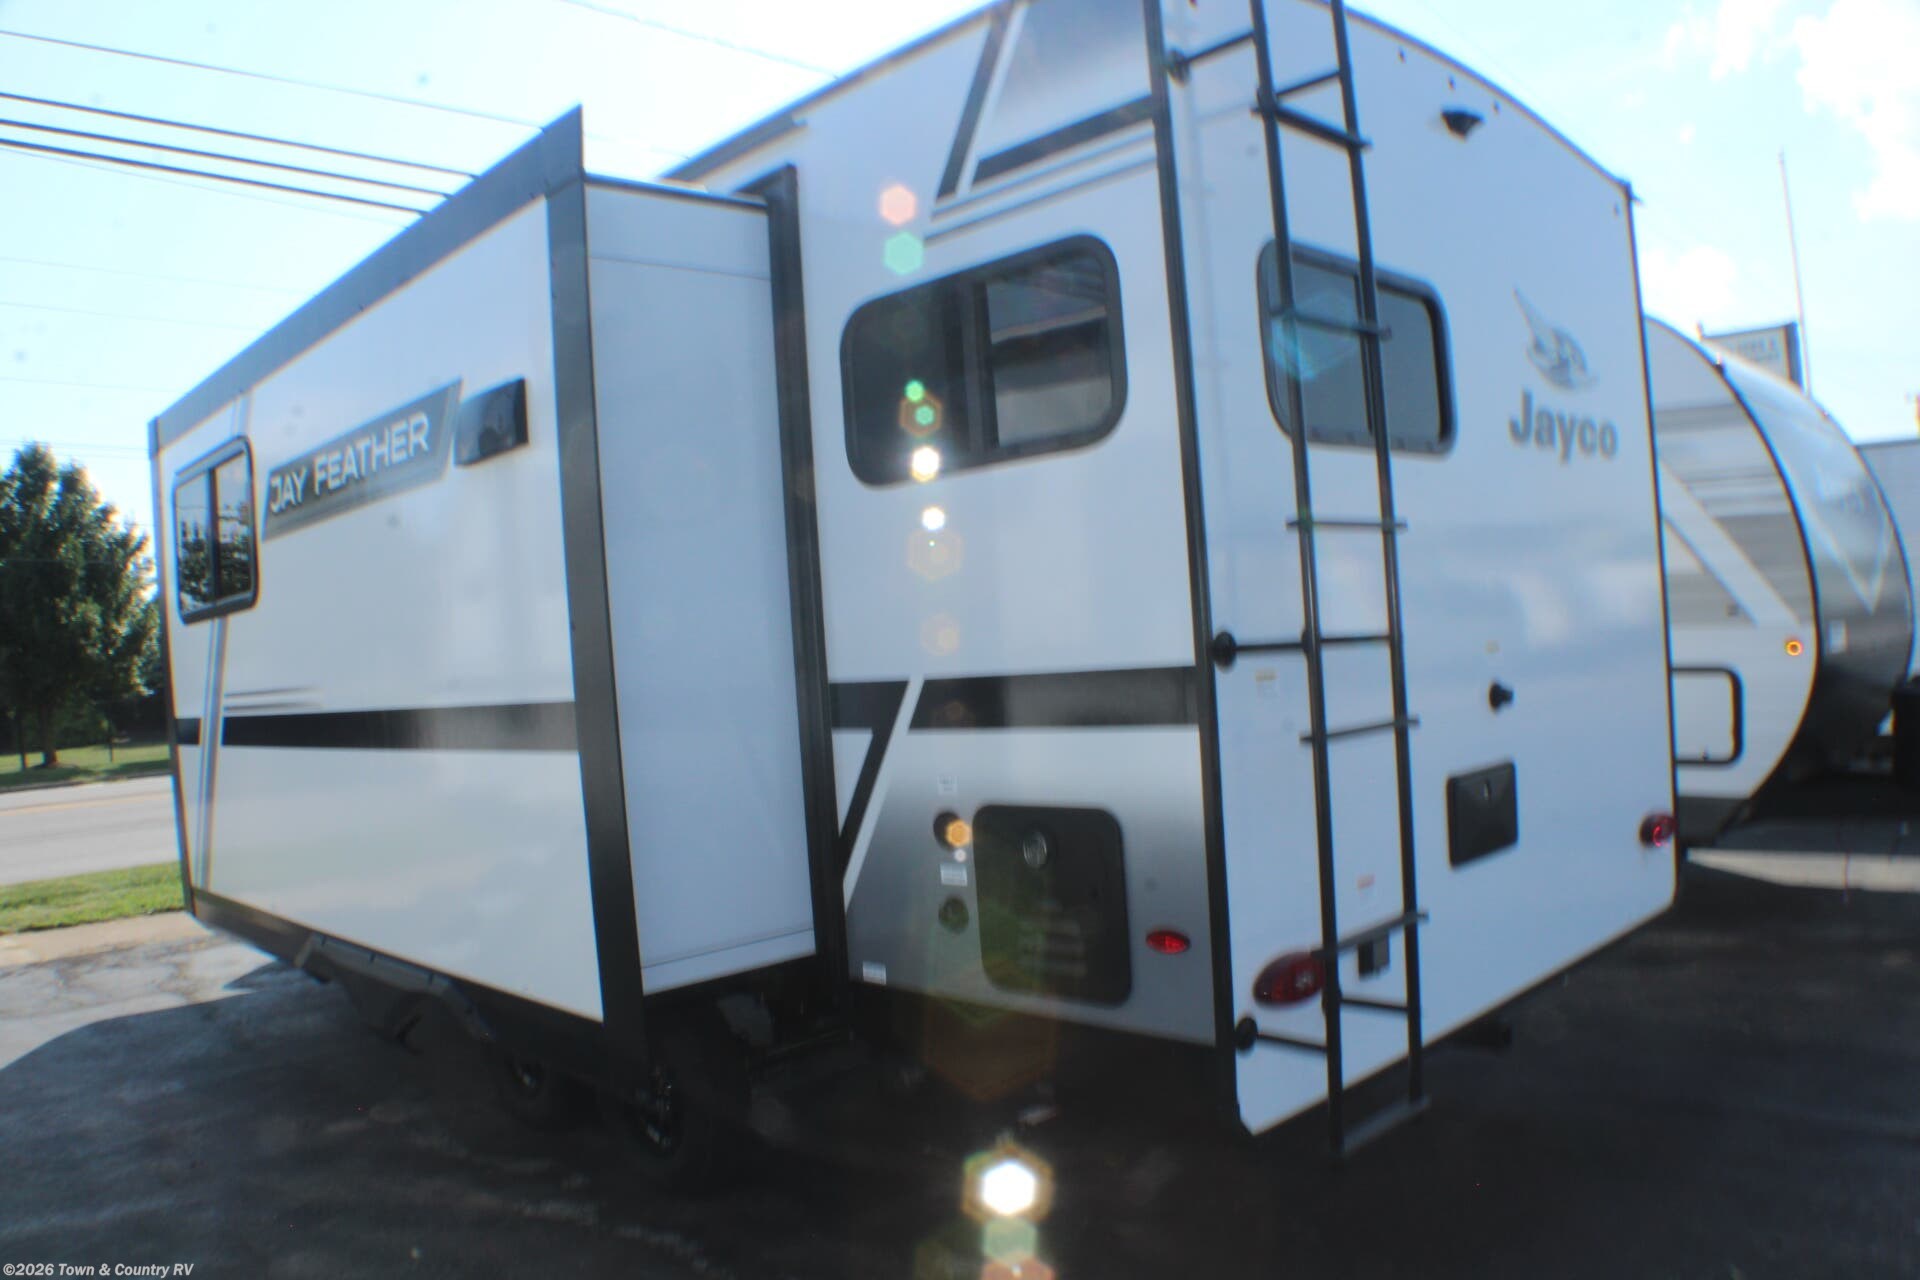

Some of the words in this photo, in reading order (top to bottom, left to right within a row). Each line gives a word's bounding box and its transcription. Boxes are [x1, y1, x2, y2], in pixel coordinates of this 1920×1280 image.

[270, 465, 307, 513] JAY
[313, 411, 430, 496] FEATHER
[1508, 388, 1619, 463] Jayco
